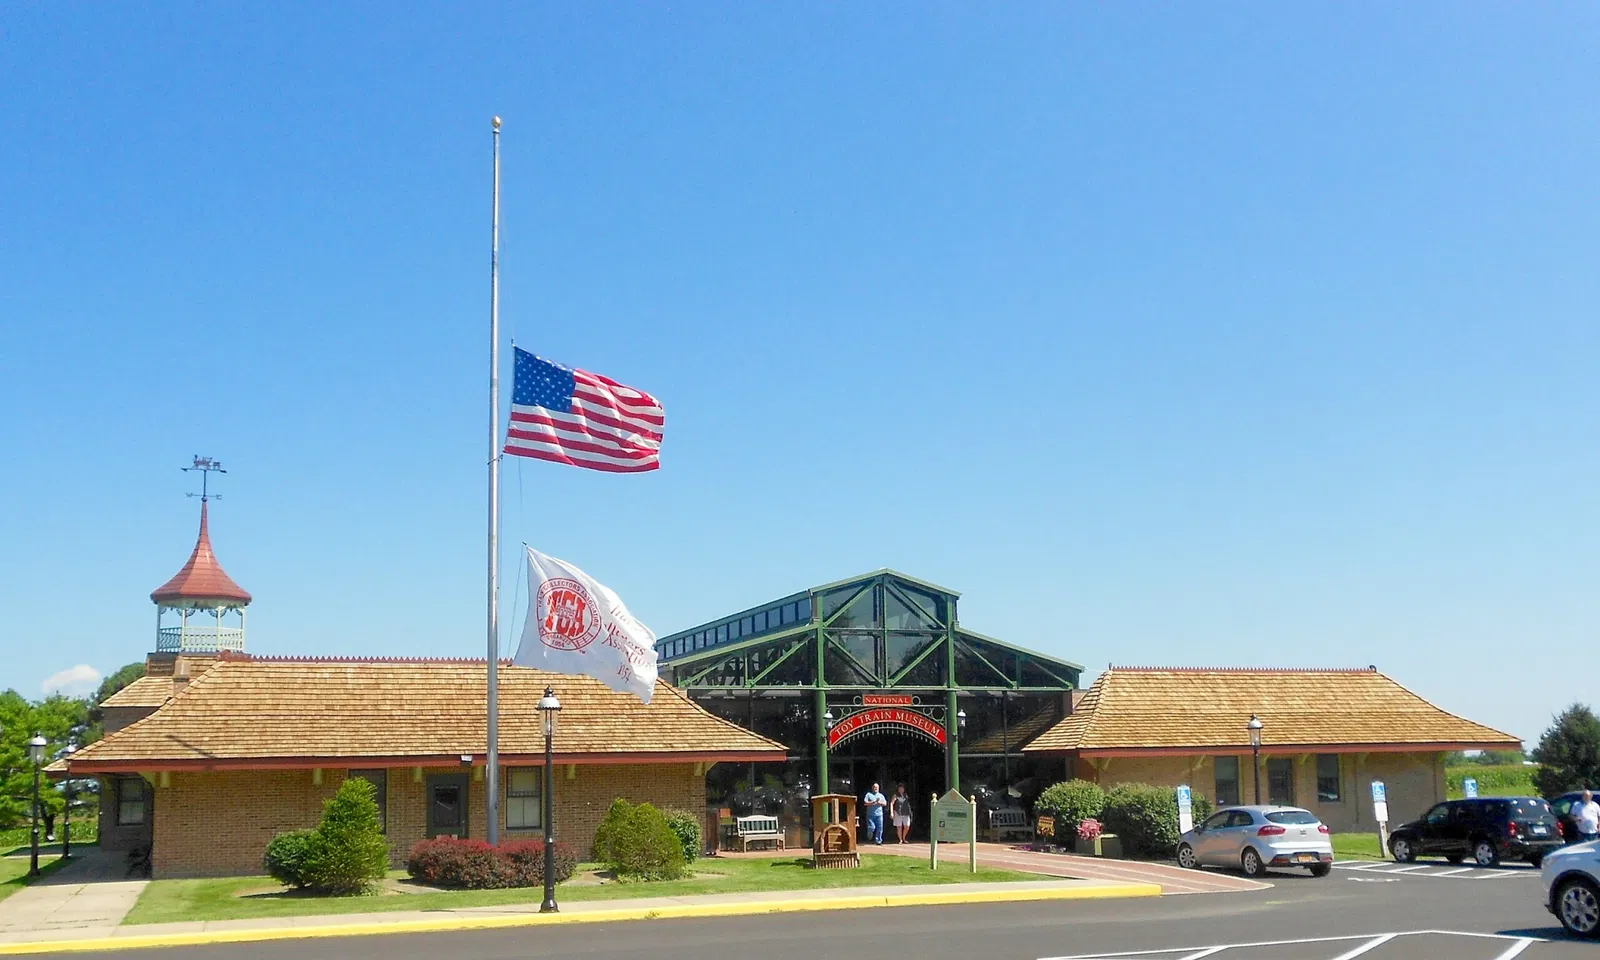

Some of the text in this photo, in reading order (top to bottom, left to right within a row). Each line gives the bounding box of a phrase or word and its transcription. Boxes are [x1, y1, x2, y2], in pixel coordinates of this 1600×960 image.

[543, 580, 580, 592] COLLECTORS
[580, 590, 599, 628] ASSOCIATION
[834, 711, 940, 737] TOY TRAIN MUSEUM
